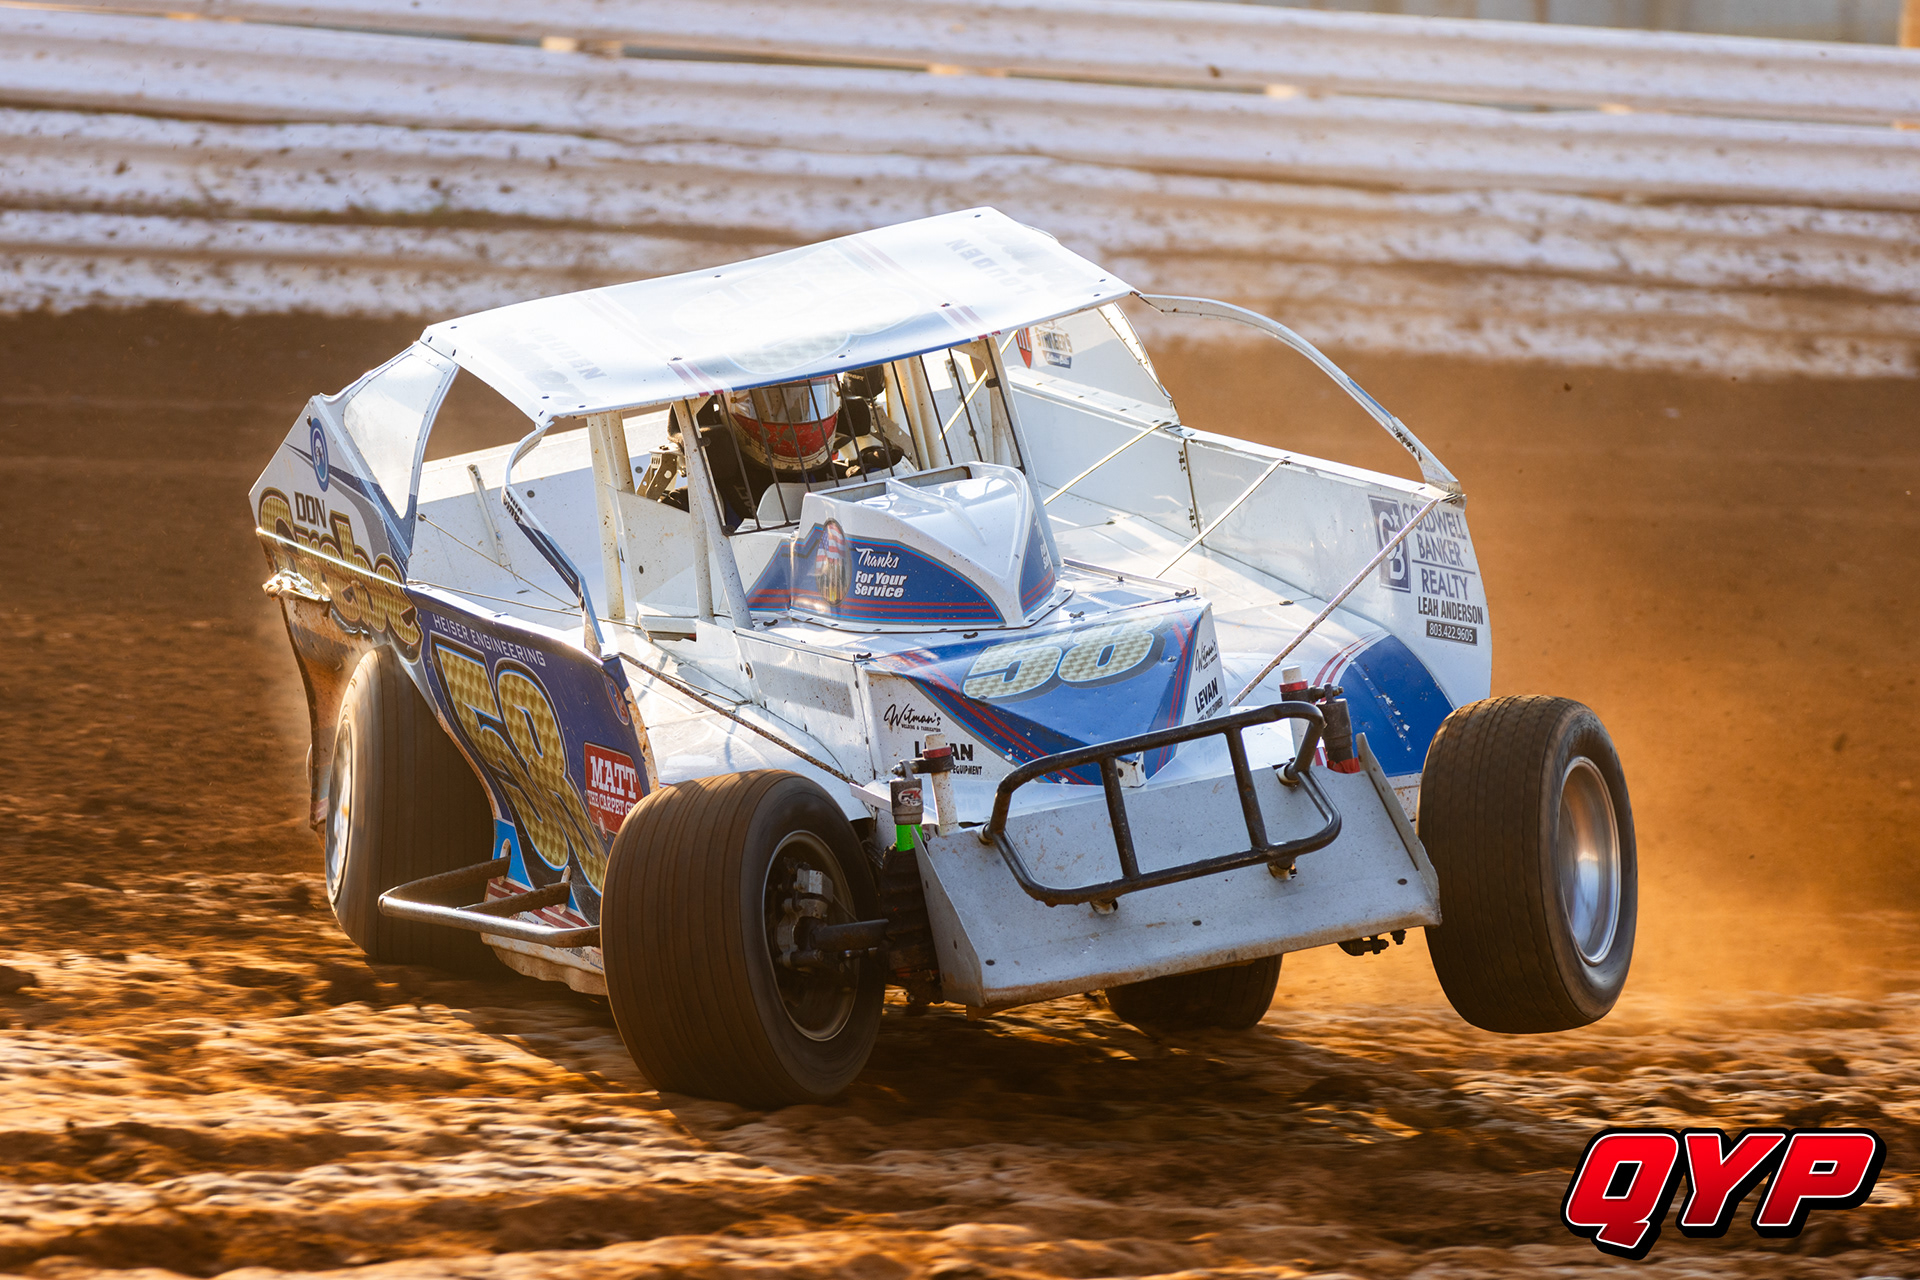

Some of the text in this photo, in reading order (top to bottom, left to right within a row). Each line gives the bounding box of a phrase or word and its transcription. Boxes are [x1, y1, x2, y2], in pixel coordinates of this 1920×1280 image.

[294, 491, 327, 528] DON
[855, 546, 900, 569] Thanks
[1416, 532, 1464, 568] BANKER
[854, 582, 904, 598] Service
[855, 570, 908, 586] For Your
[1421, 567, 1468, 601] REALTY
[1417, 596, 1484, 625] LEAH ANDERSON
[433, 614, 546, 667] HEISER ENGINEERING
[1429, 622, 1474, 643] 803.422.9605
[1195, 677, 1218, 714] LEVAN
[914, 740, 974, 762] LAN
[431, 634, 608, 898] 58
[590, 755, 637, 800] MATT
[952, 764, 983, 776] EQUIPMENT
[586, 789, 600, 808] THE
[600, 793, 625, 816] CARPET
